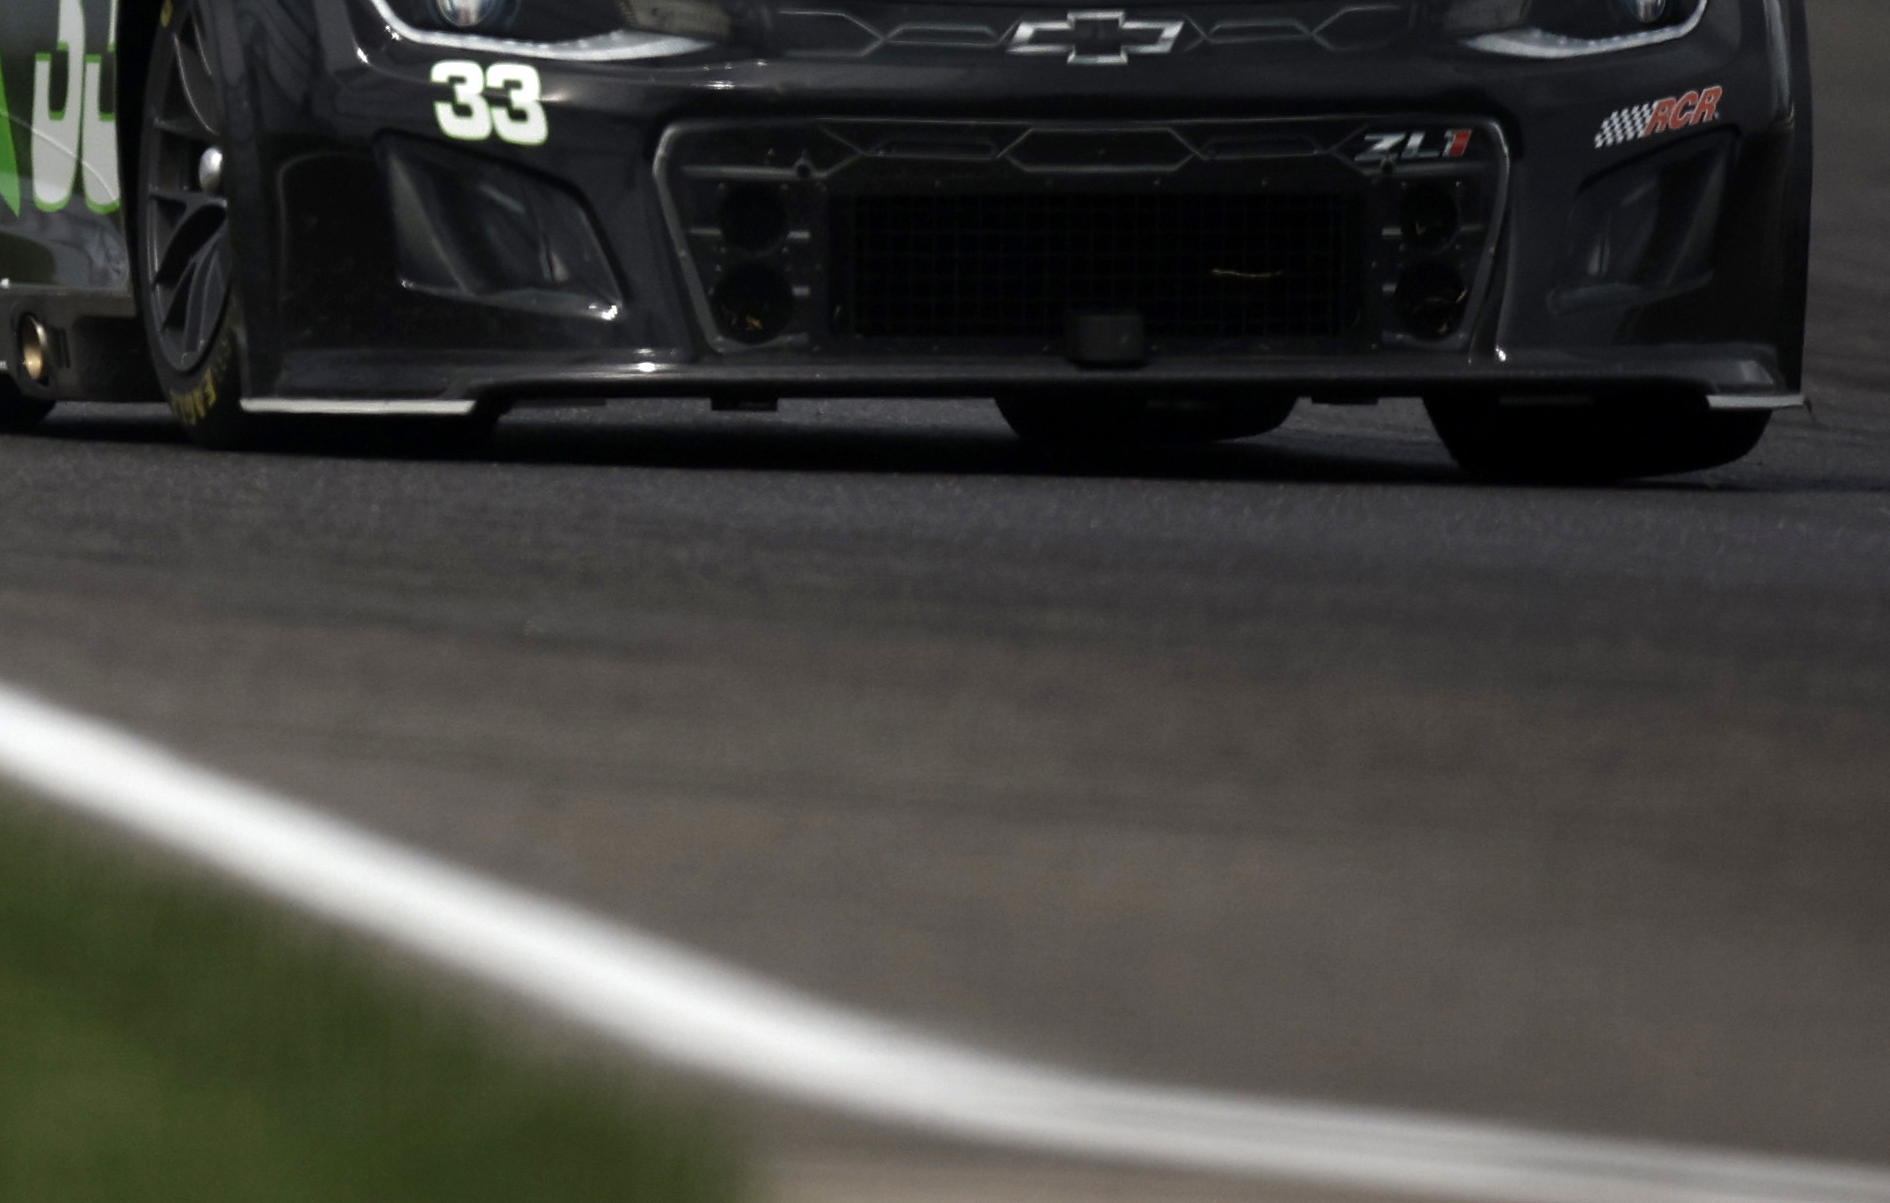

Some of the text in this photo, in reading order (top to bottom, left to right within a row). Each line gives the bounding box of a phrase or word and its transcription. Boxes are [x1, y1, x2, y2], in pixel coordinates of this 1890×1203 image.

[430, 60, 549, 146] 33
[1644, 85, 1723, 136] RCR
[1354, 129, 1473, 162] ZL1
